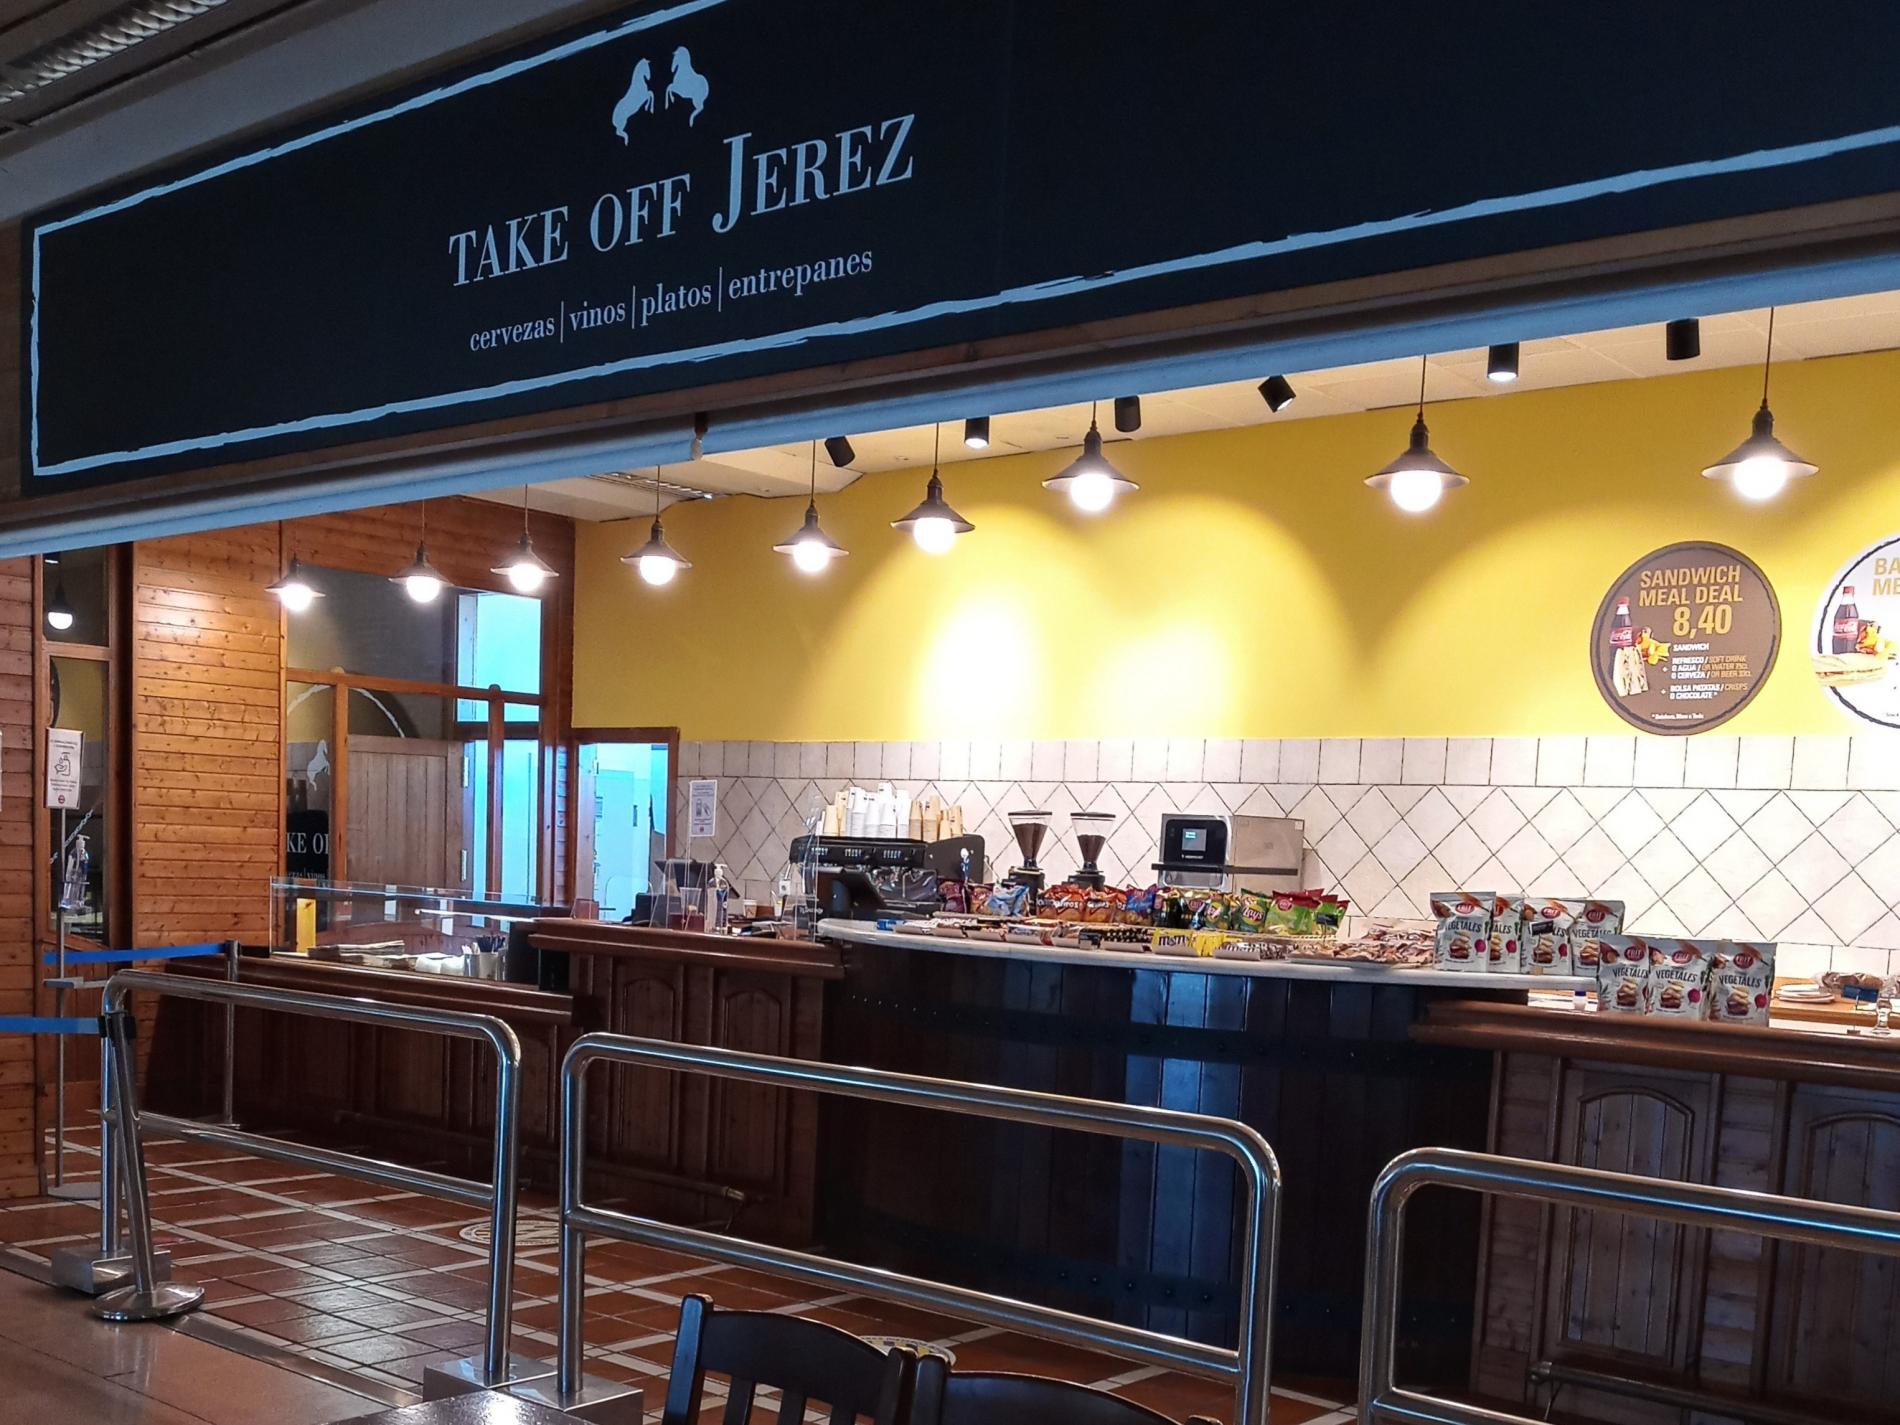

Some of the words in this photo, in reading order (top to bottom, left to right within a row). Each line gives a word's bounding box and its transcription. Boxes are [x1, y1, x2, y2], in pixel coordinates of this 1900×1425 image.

[448, 205, 569, 287] TAKE
[589, 173, 691, 253] OFF
[712, 113, 915, 233] JEREZ
[469, 313, 556, 352] cervezas
[568, 301, 627, 333] vinos
[640, 282, 713, 326] platos
[728, 249, 874, 298] entrepanes
[1640, 565, 1741, 588] SANDWICH
[1639, 587, 1691, 607] MEAL
[1695, 584, 1744, 604] DEAL
[1673, 604, 1733, 639] 8,40
[1673, 642, 1710, 652] SANDWICH
[1656, 969, 1698, 983] VEGETALES
[1719, 974, 1762, 988] VEGETALES
